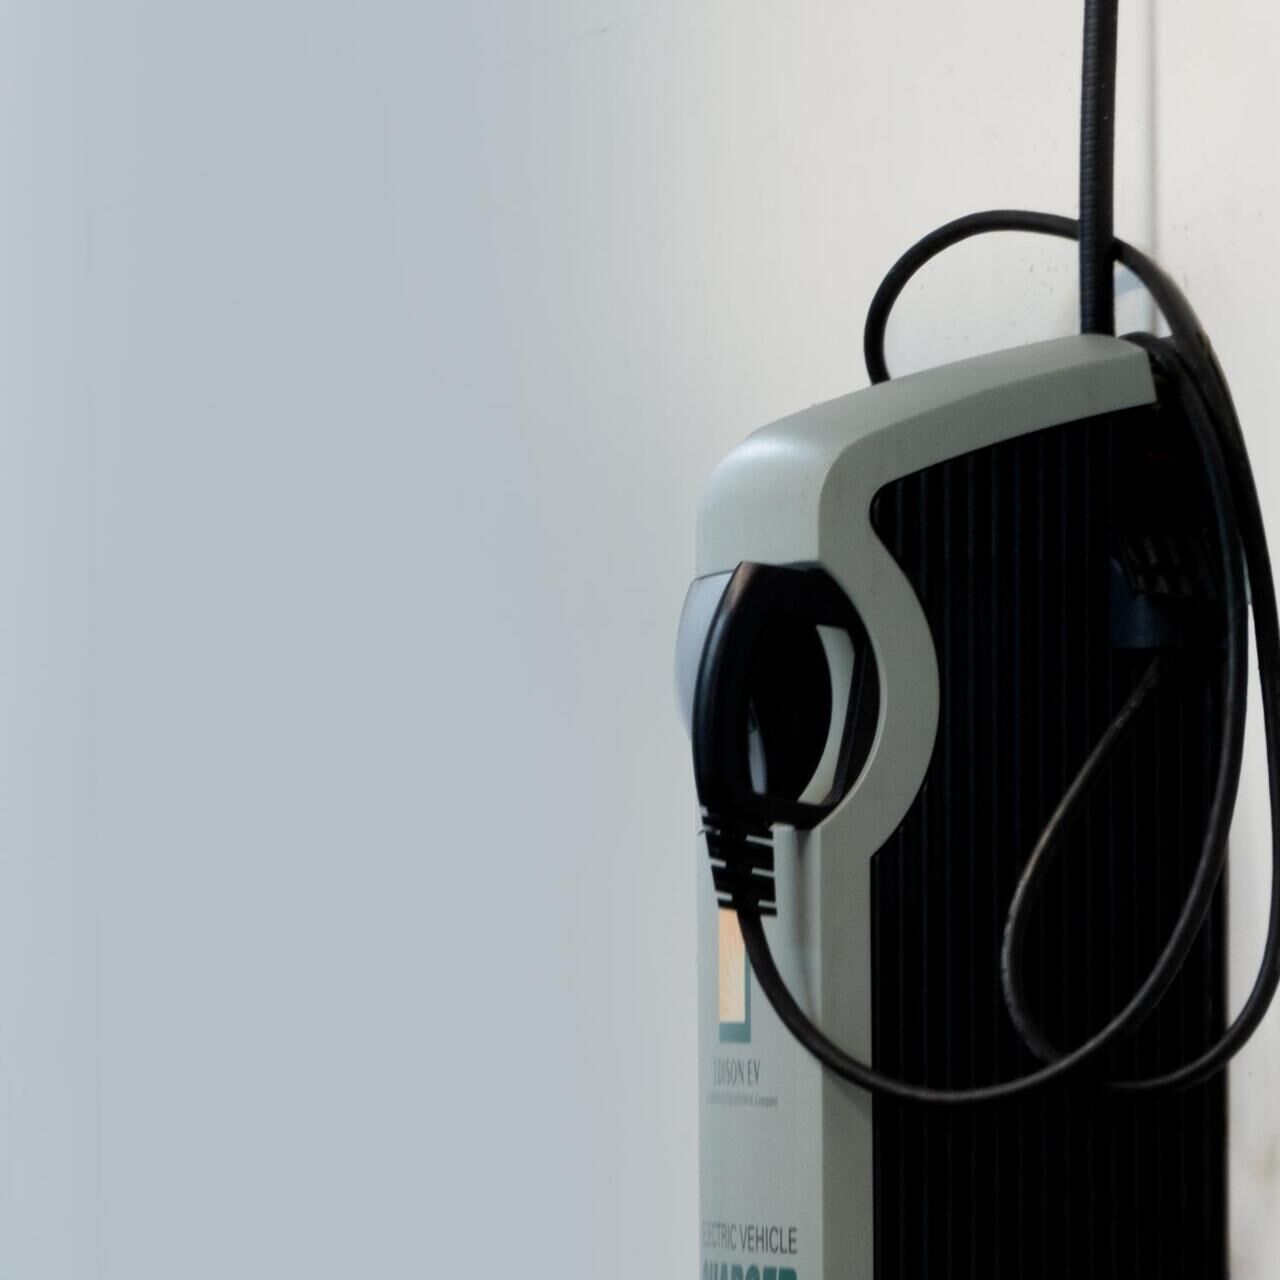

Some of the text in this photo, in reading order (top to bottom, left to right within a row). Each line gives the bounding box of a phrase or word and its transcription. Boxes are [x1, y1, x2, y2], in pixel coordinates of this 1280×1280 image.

[713, 1057, 761, 1087] EDISON EV
[740, 1223, 798, 1255] VEHICLE
